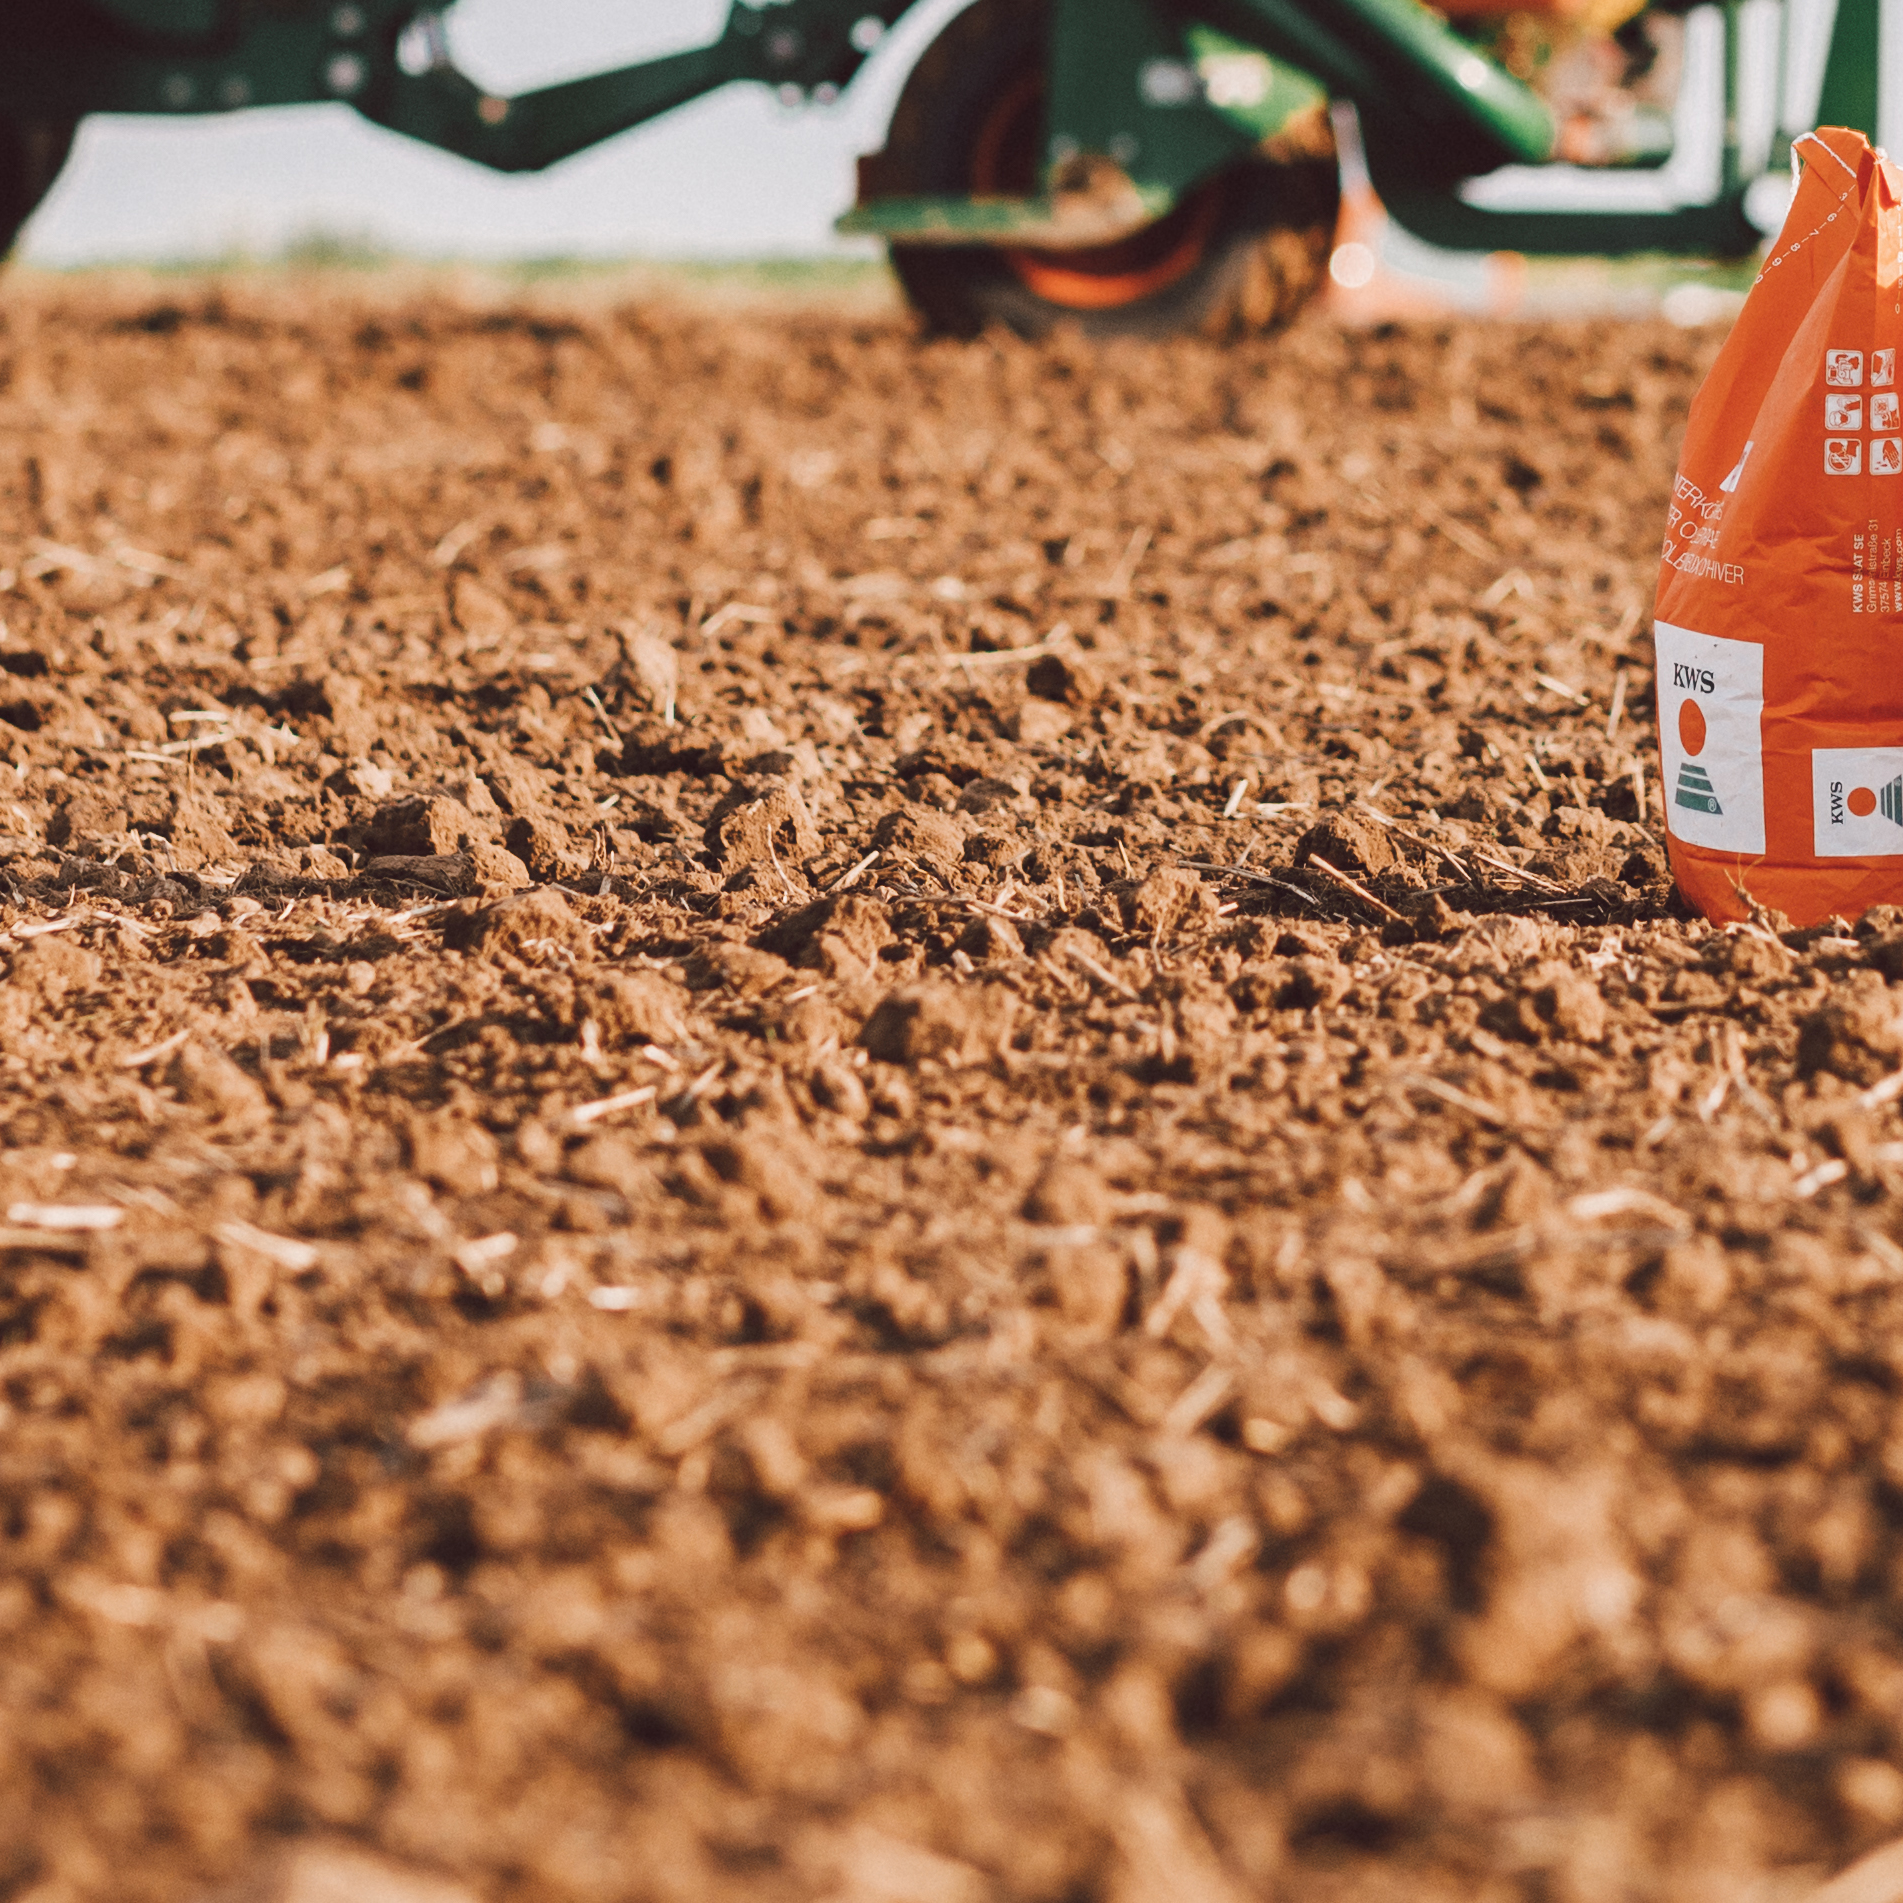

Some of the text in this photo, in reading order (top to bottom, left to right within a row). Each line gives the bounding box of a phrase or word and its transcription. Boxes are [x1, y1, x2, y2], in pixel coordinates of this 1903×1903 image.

[1868, 519, 1878, 531] 31
[1854, 534, 1864, 550] SE
[1894, 528, 1903, 613] www.kws.com
[1853, 583, 1864, 613] KWS
[1879, 581, 1890, 613] 37574
[1673, 662, 1715, 694] KWS
[1830, 781, 1844, 825] KWS
